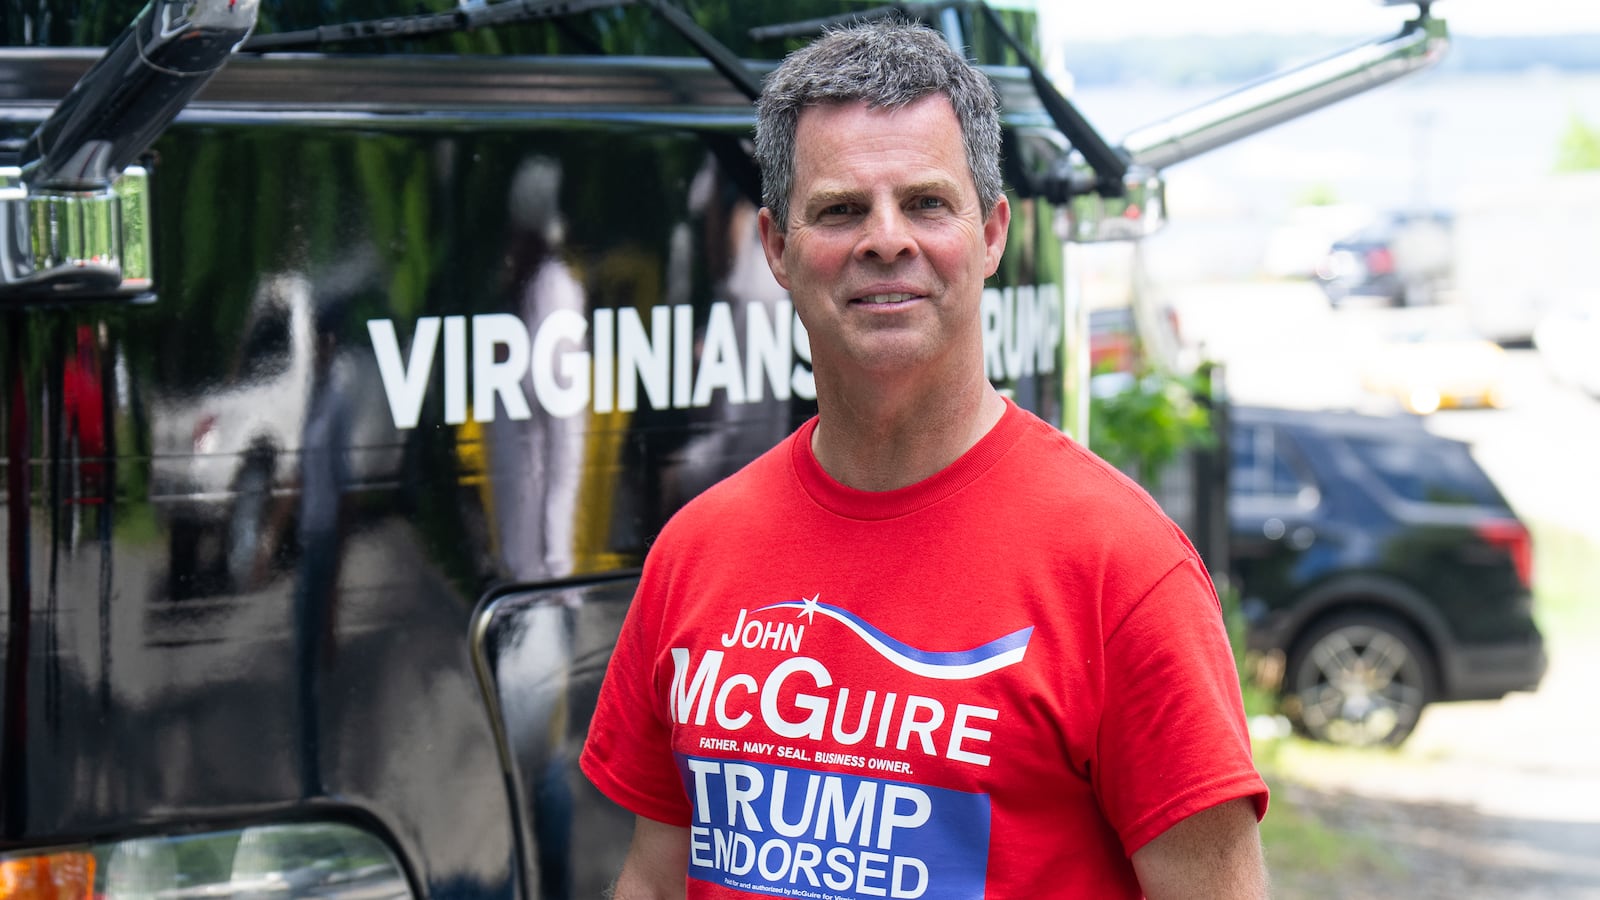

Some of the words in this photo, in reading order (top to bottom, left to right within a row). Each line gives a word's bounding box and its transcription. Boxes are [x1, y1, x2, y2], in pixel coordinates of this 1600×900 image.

[981, 283, 1060, 380] RUMP
[721, 608, 805, 653] JOHN
[699, 737, 740, 752] FATHER.
[743, 741, 775, 756] NAVY
[777, 746, 811, 762] SEAL.
[814, 751, 866, 768] BUSINESS
[868, 758, 914, 775] OWNER.
[688, 758, 932, 850] TRUMP
[690, 825, 929, 899] ENDORSED
[752, 884, 784, 894] authorized
[783, 888, 792, 896] by
[792, 889, 822, 899] McGuire
